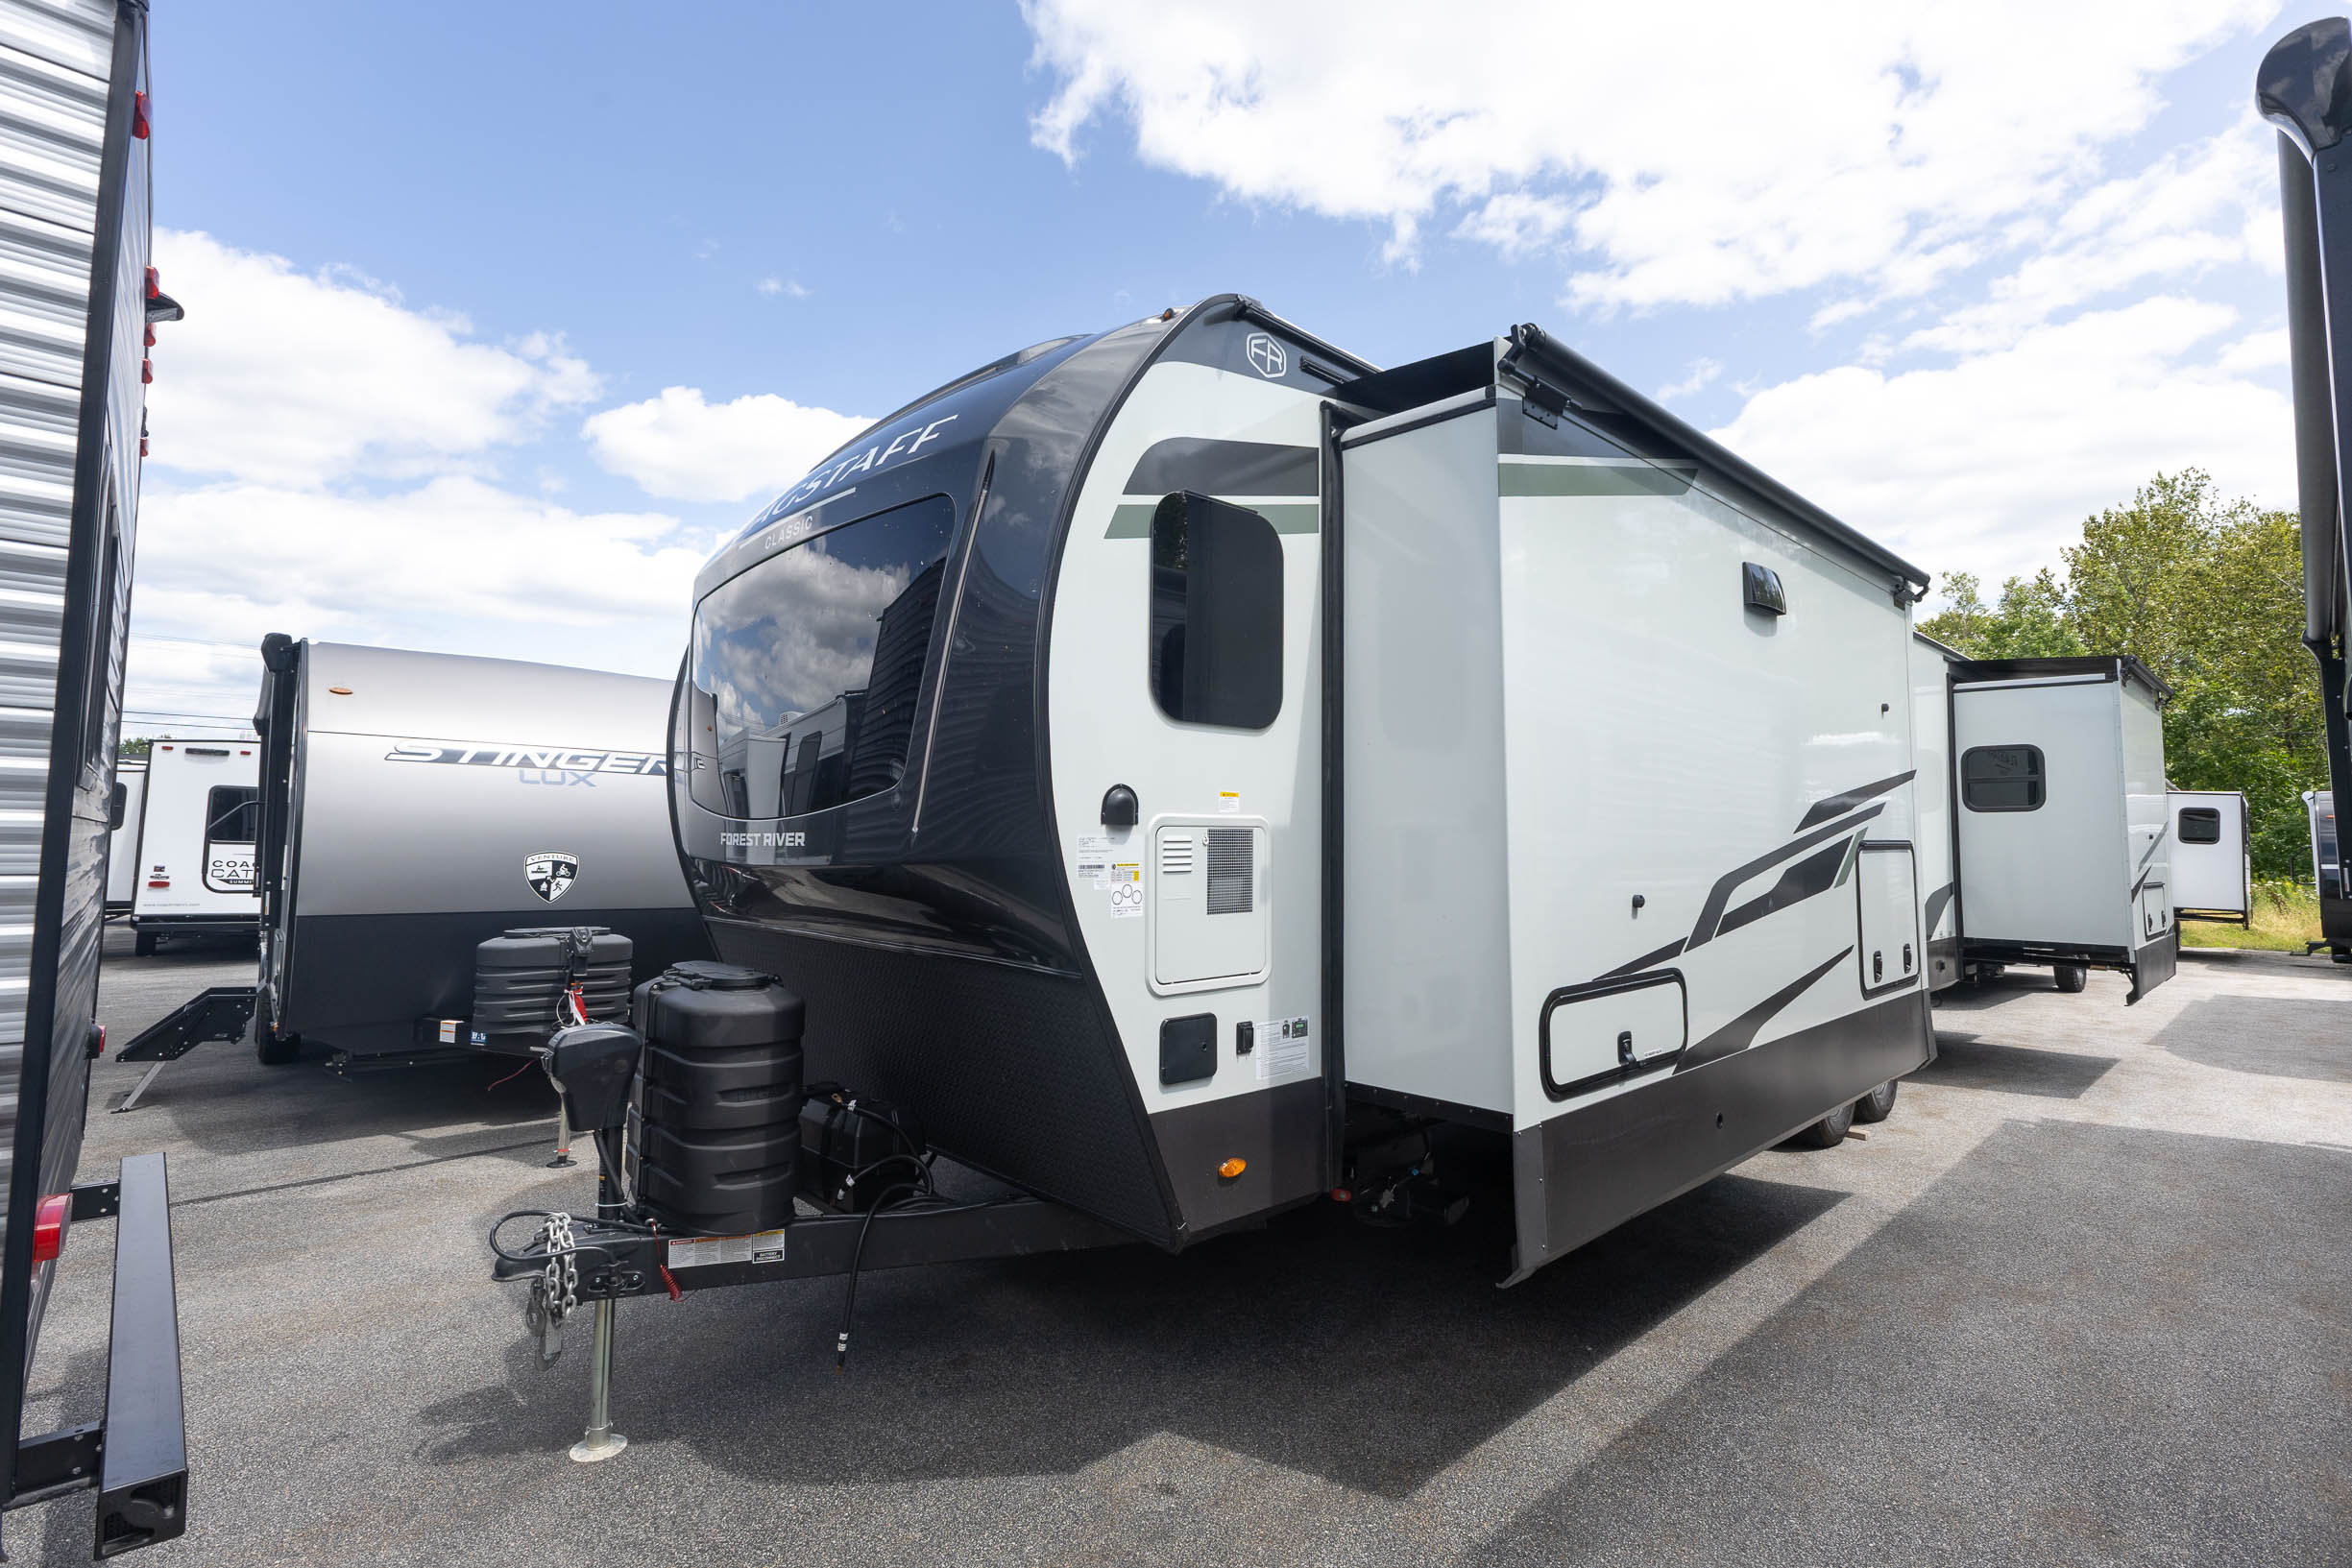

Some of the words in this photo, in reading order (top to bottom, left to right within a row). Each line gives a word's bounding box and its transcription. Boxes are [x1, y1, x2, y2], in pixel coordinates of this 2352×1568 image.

[741, 414, 959, 534] AGSTAFF
[764, 516, 814, 550] CLASSIC
[519, 768, 597, 787] LUX
[720, 832, 761, 846] FOREST
[763, 832, 806, 847] RIVER
[530, 854, 574, 862] VENTURE
